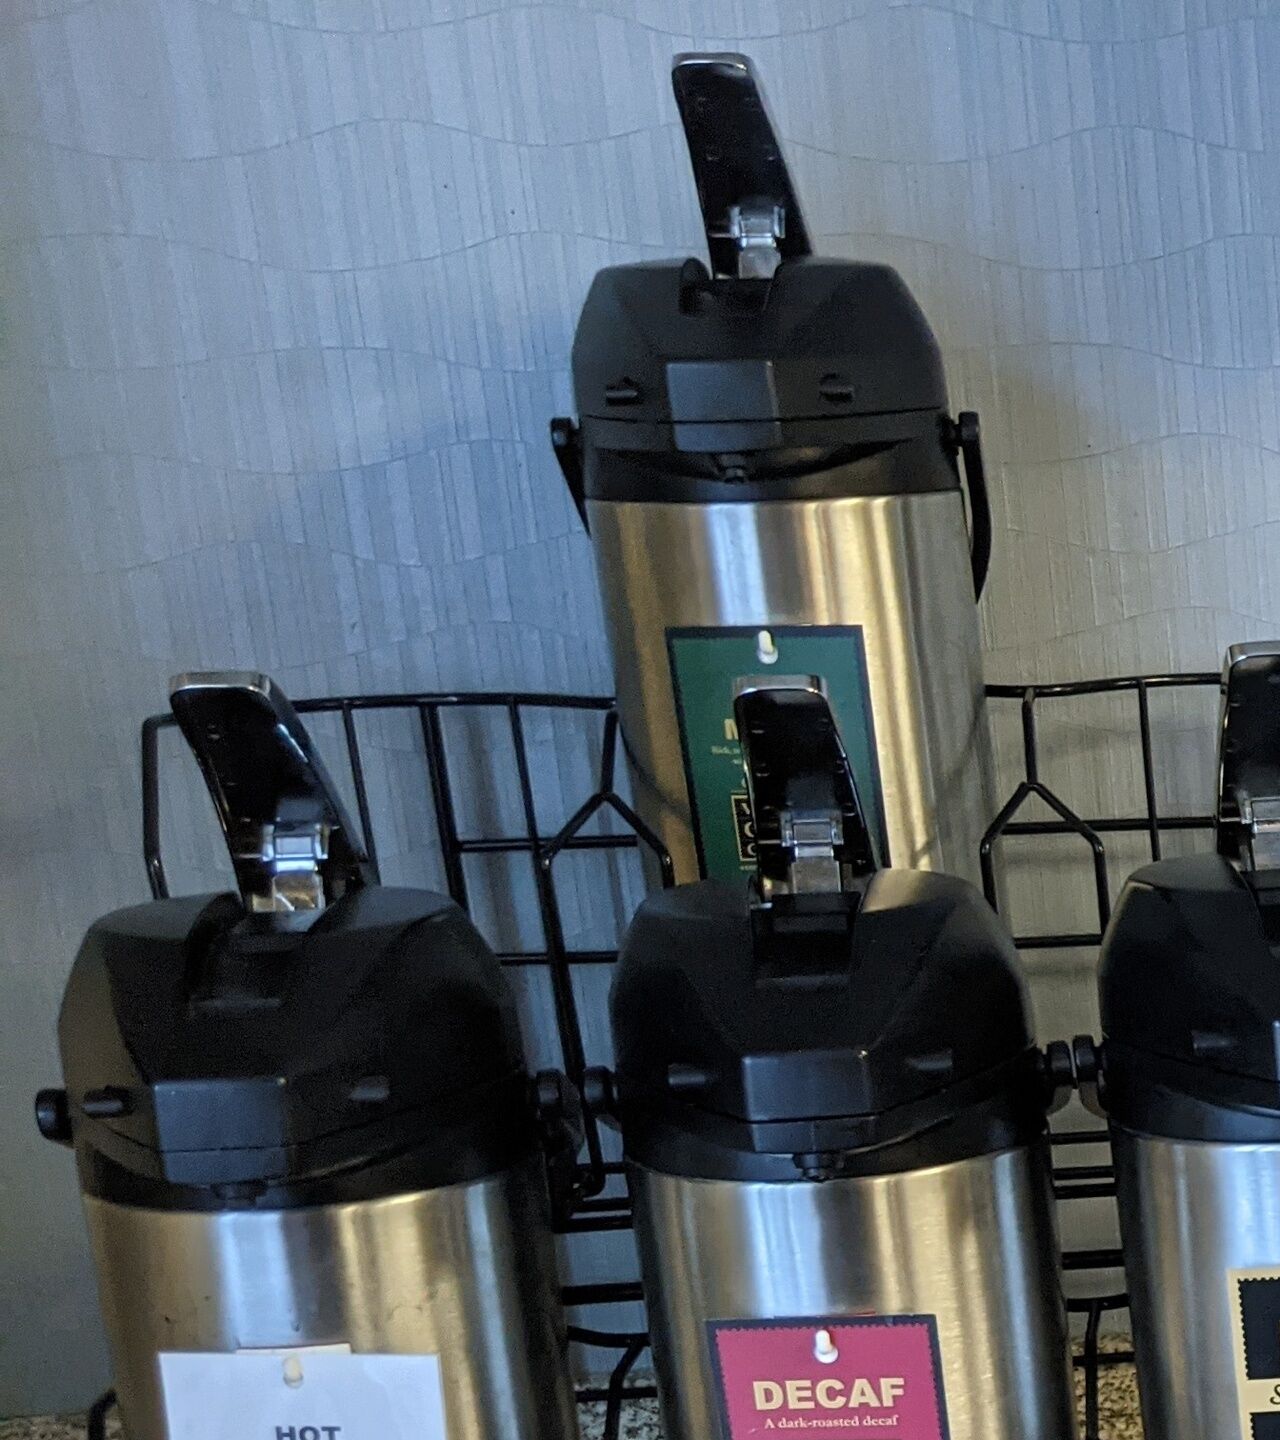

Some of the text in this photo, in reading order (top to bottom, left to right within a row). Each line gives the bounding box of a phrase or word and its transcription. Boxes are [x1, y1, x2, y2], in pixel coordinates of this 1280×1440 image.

[752, 1377, 905, 1411] DECAF
[765, 1415, 898, 1429] A dark-roasted decaf
